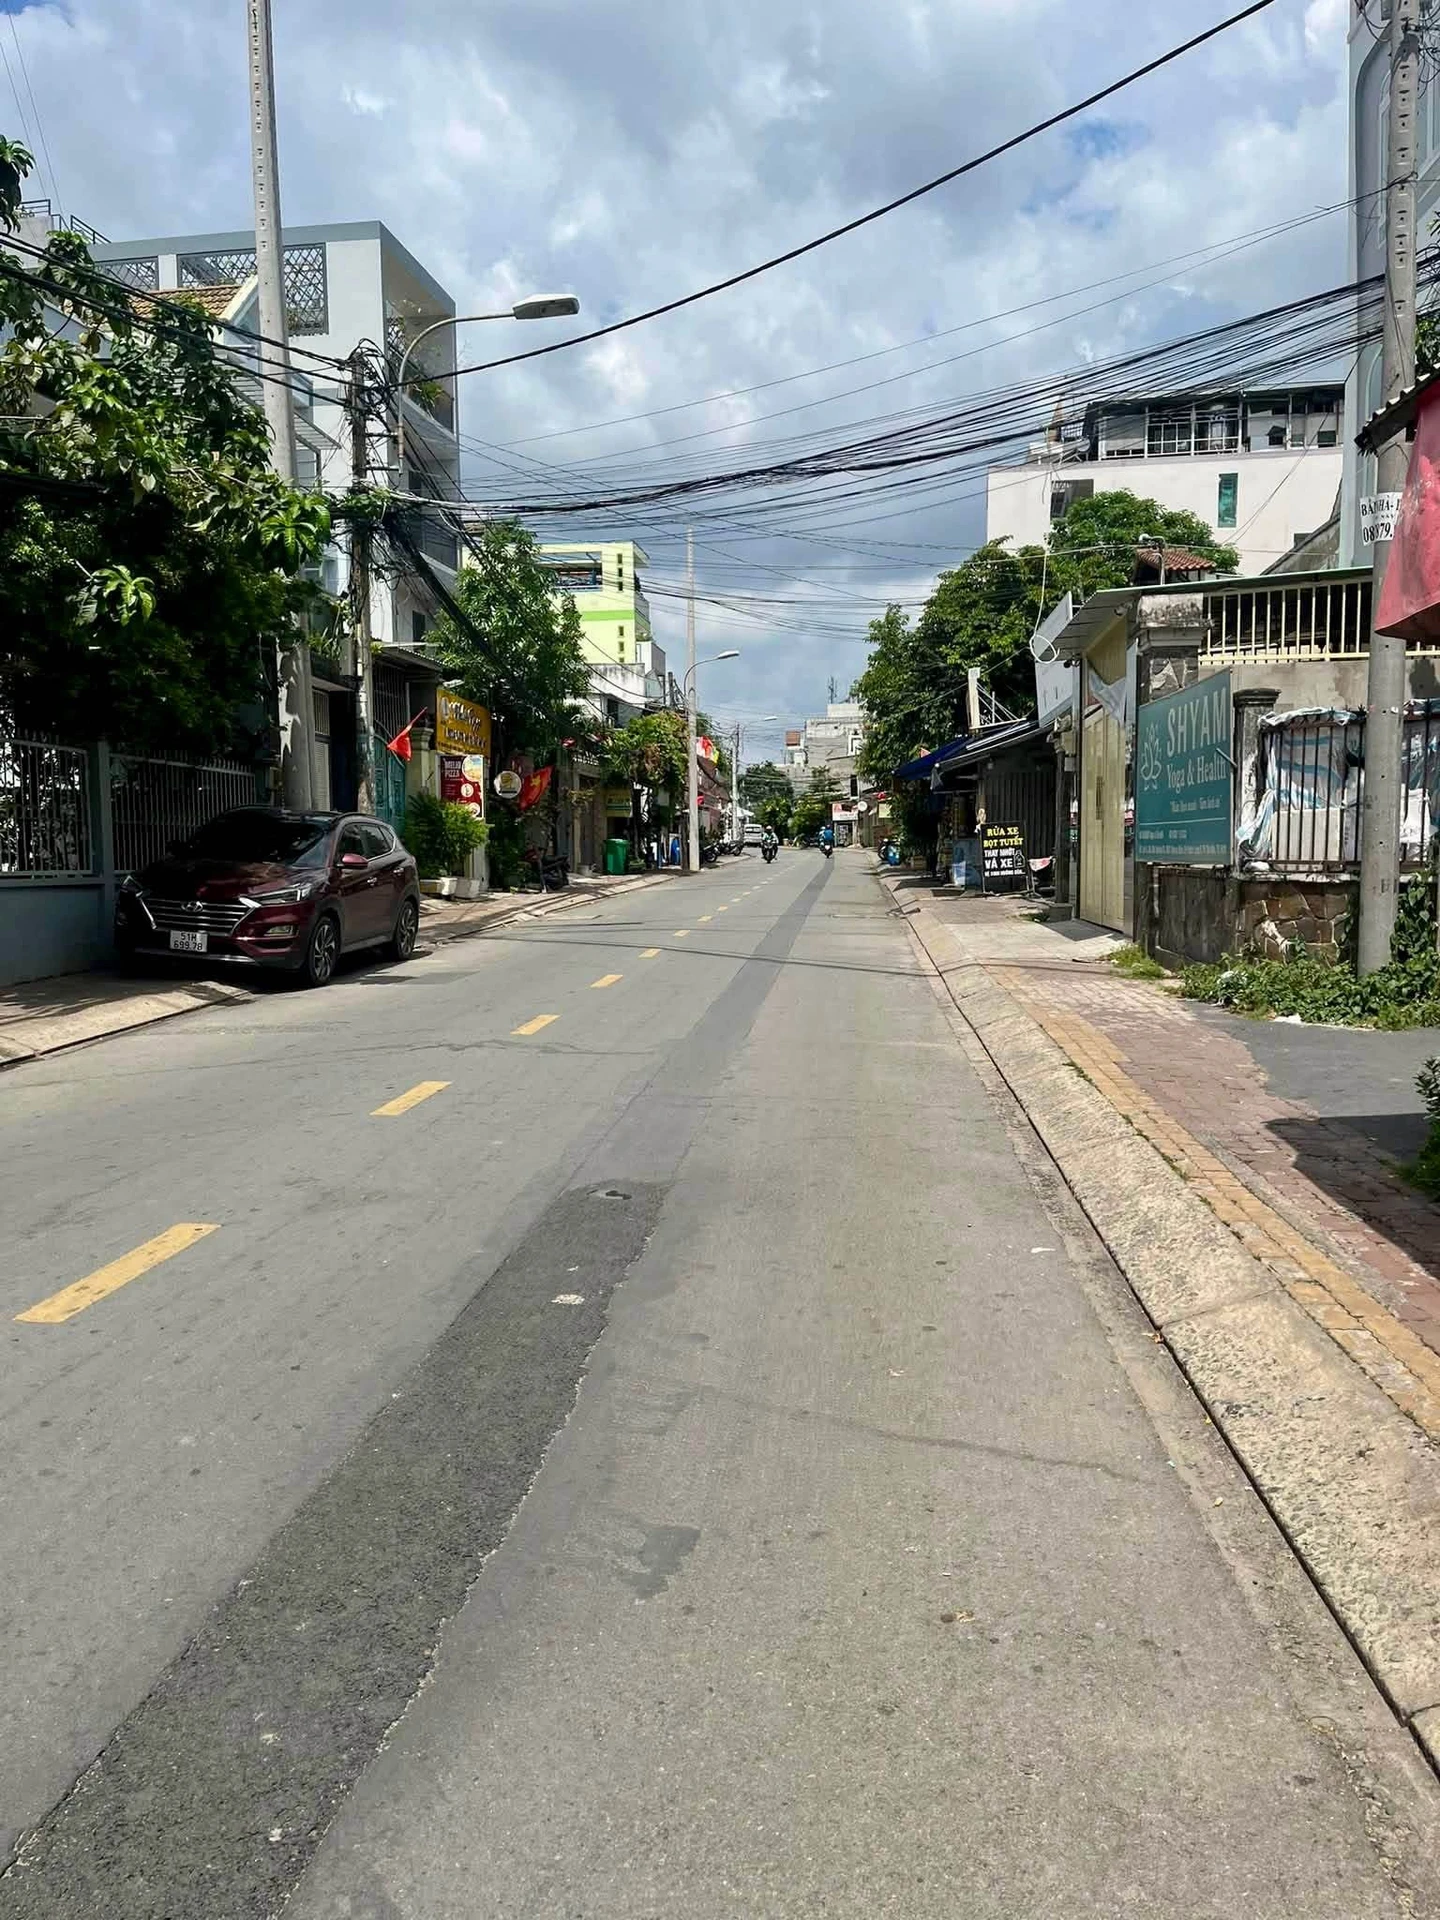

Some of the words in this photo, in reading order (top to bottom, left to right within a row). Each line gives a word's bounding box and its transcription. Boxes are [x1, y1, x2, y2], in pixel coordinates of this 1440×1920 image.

[1167, 687, 1226, 758] SHYAM
[1167, 763, 1185, 794] Yoga
[1187, 759, 1195, 787] &
[1197, 752, 1226, 784] Health
[1007, 826, 1019, 836] XE
[999, 835, 1024, 846] TUYẾT
[1000, 858, 1013, 868] XE
[180, 932, 197, 942] 51H
[173, 940, 203, 951] 699.78
